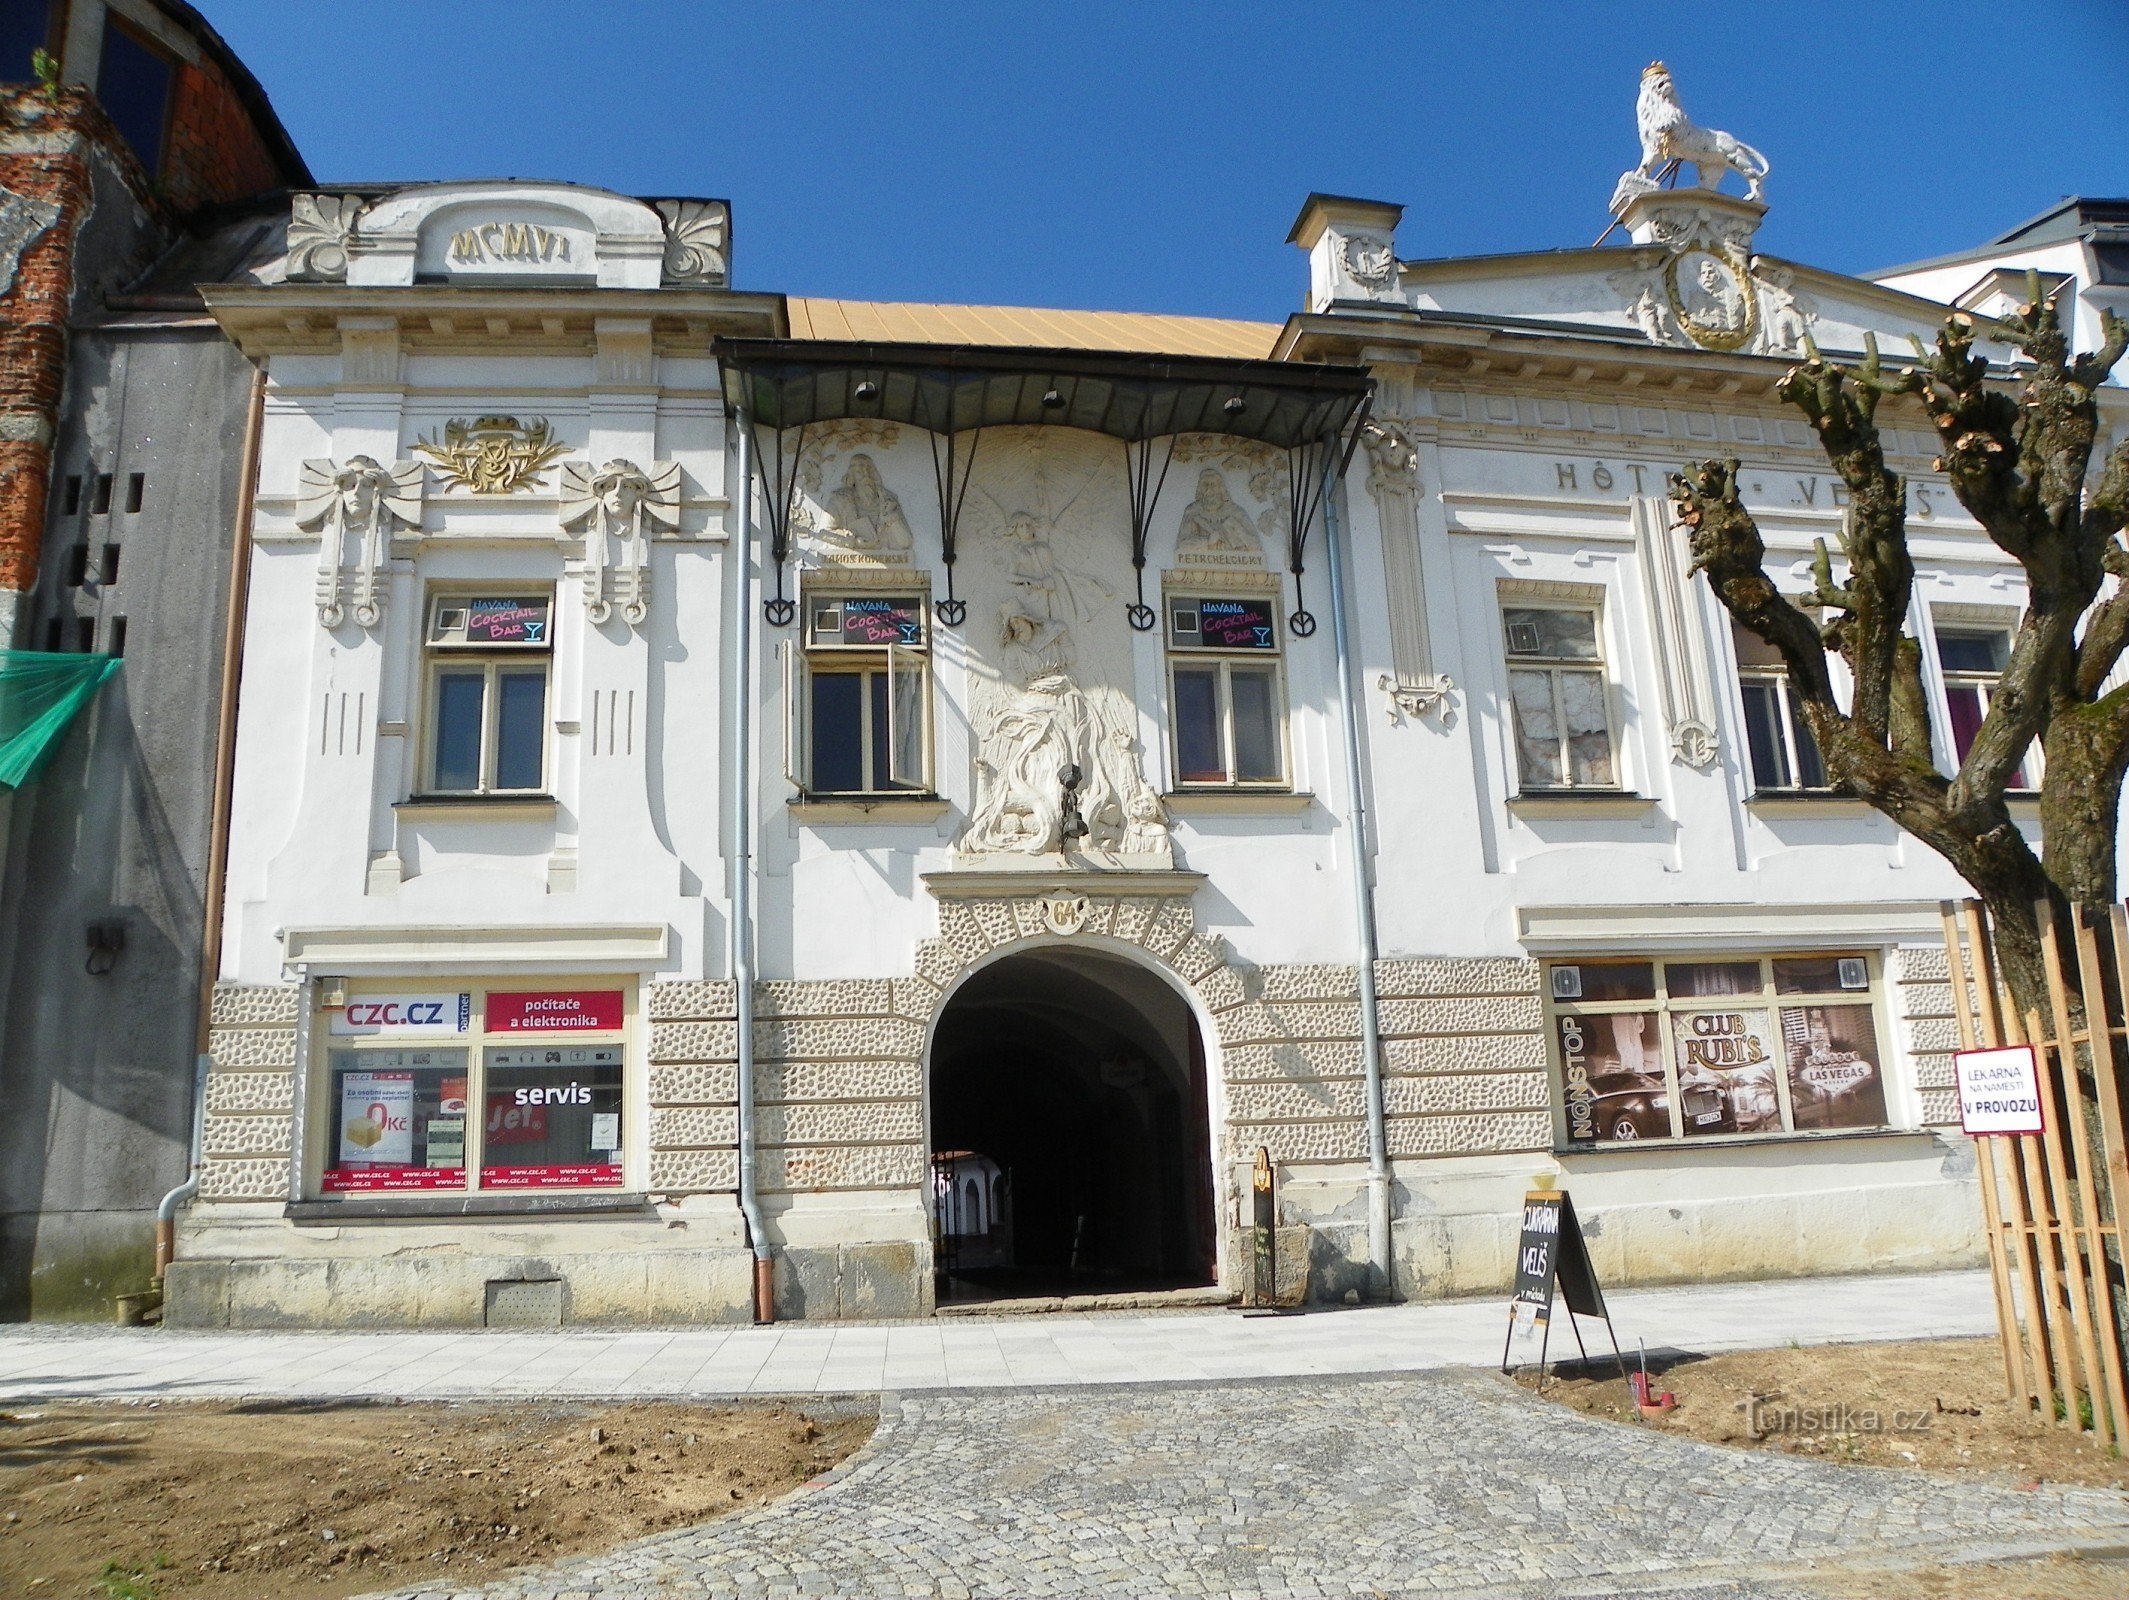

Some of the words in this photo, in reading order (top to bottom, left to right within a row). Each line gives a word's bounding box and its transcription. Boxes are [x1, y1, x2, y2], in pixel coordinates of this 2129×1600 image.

[452, 222, 567, 259] MCMVI
[473, 600, 518, 610] HAVANA
[845, 600, 891, 612] HAVANA
[1202, 602, 1245, 613] HAVANA
[460, 994, 470, 1032] partner
[525, 998, 581, 1013] počítače
[347, 1003, 443, 1025] CZC.CZ
[510, 1018, 519, 1027] a
[522, 1014, 598, 1027] elektronika
[1692, 1014, 1746, 1036] CLUB
[1562, 1016, 1593, 1139] NONSTOP
[1809, 1070, 1828, 1081] LAS
[1829, 1067, 1864, 1079] VEGAS
[514, 1081, 593, 1106] servis
[1970, 1085, 1982, 1093] NA
[1964, 1102, 1972, 1114] V
[1976, 1099, 2037, 1113] PROVOZU
[388, 1117, 407, 1131] Kč
[383, 1179, 422, 1187] www.czc.cz
[1522, 1241, 1549, 1278] VELIŠ
